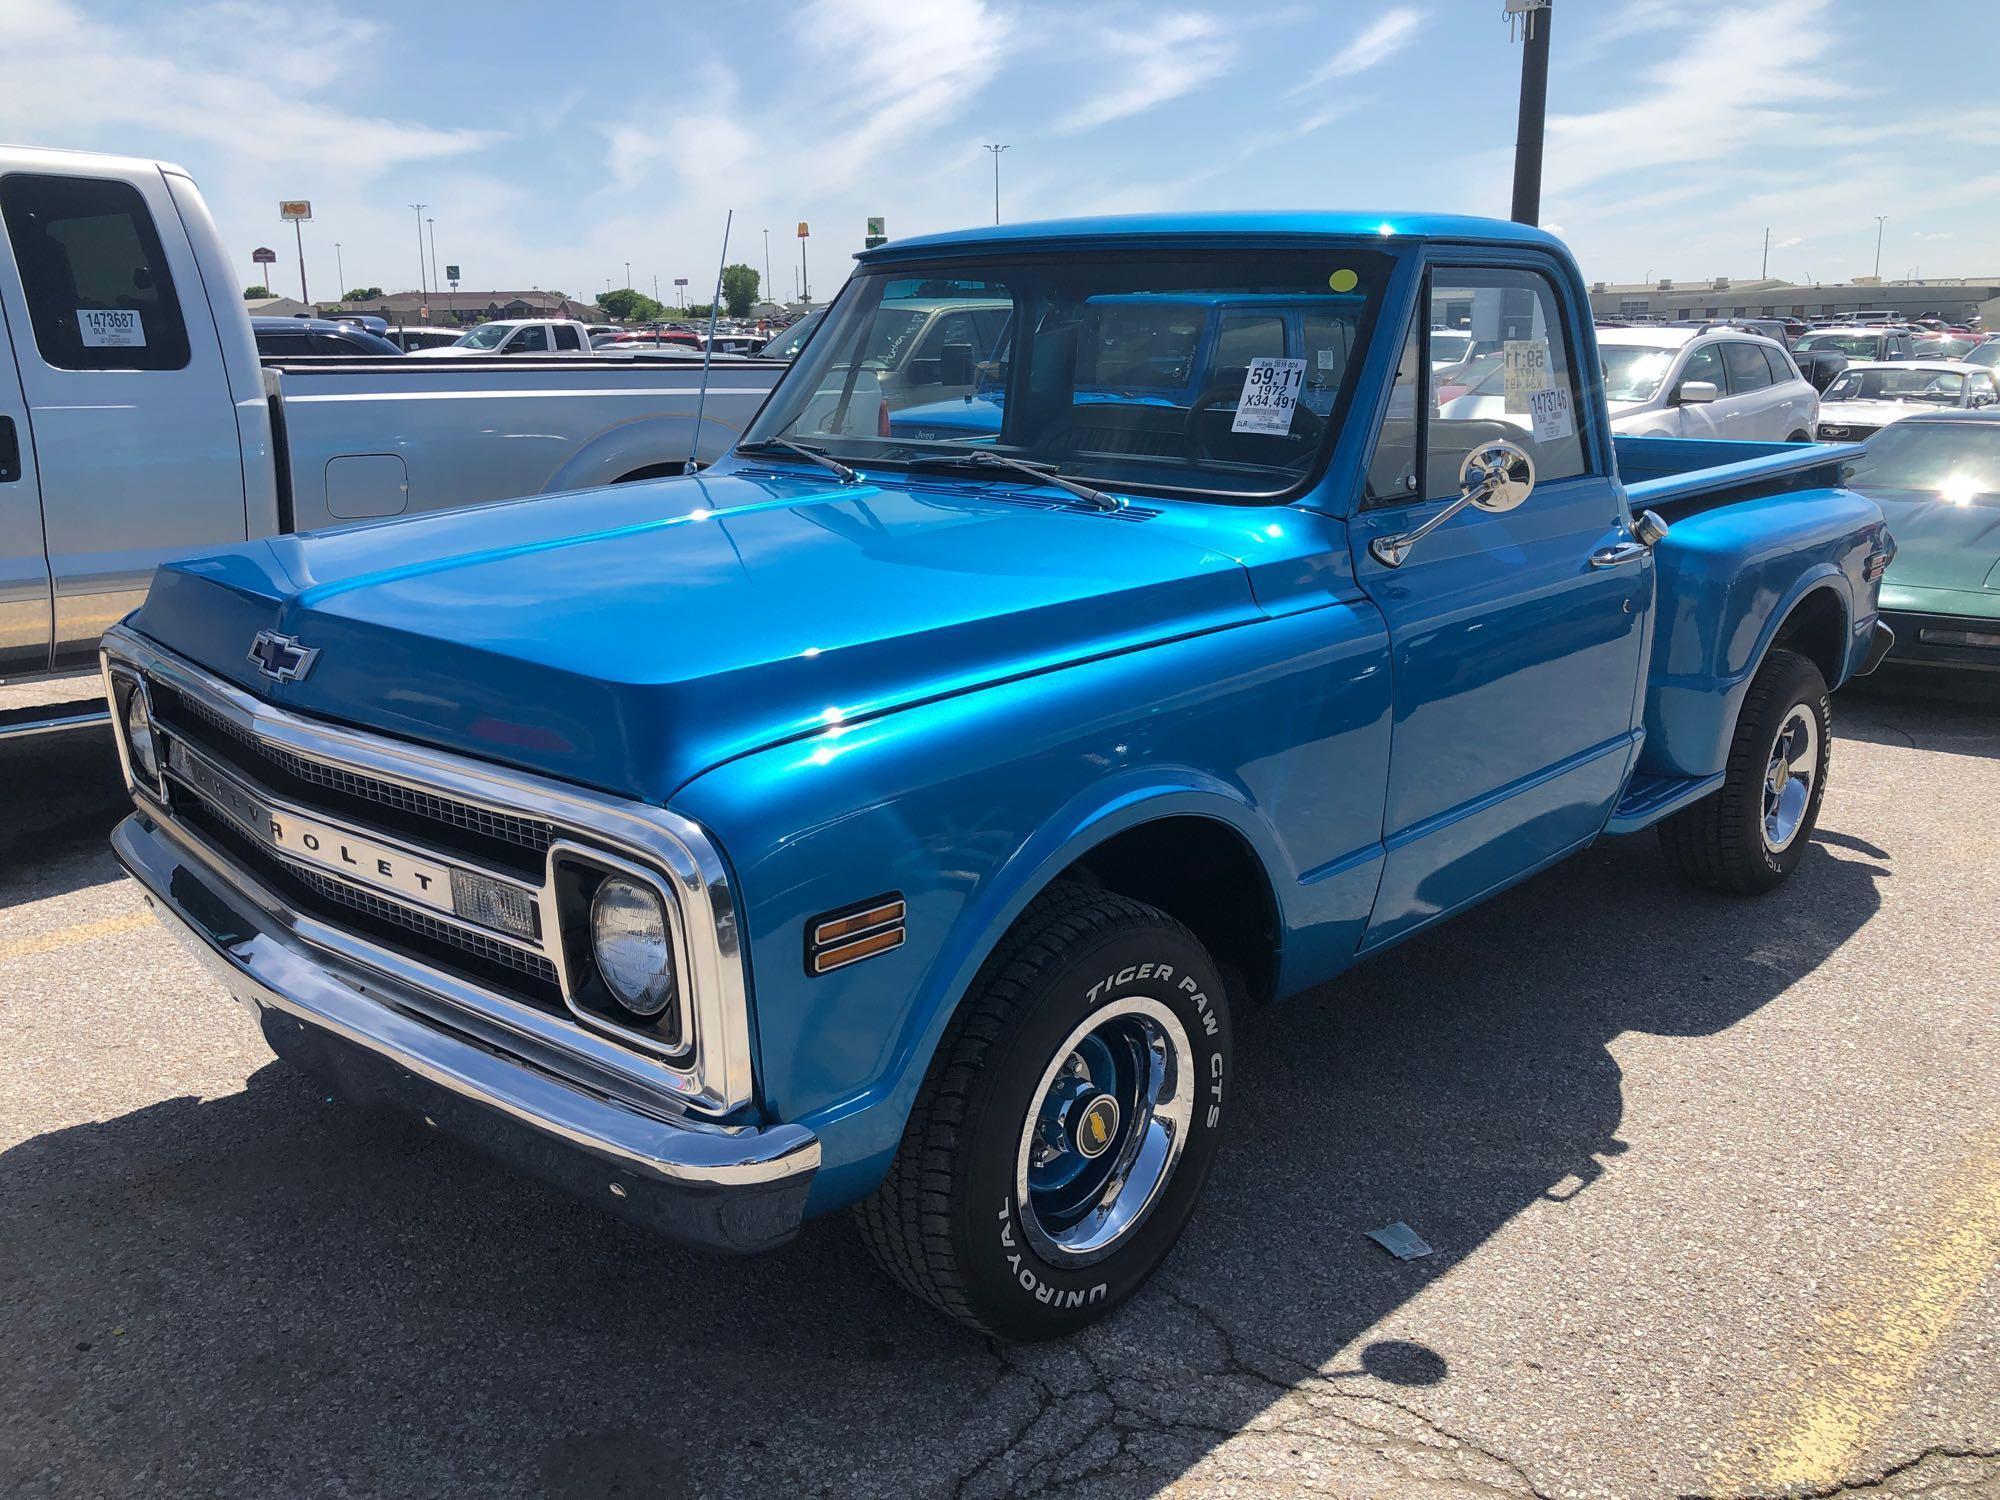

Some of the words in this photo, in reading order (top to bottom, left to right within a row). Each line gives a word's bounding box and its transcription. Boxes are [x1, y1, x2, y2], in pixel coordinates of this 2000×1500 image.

[86, 312, 134, 328] 1473687
[93, 327, 106, 335] DLR
[1250, 367, 1303, 387] 59:11
[1258, 385, 1287, 396] 1972
[1245, 394, 1296, 410] X34,491
[1531, 389, 1568, 414] 1473746
[1086, 962, 1175, 1004] TIGER
[1177, 975, 1219, 1036] PAW
[1206, 1052, 1224, 1129] GTS
[998, 1196, 1108, 1309] UNIROYAL
